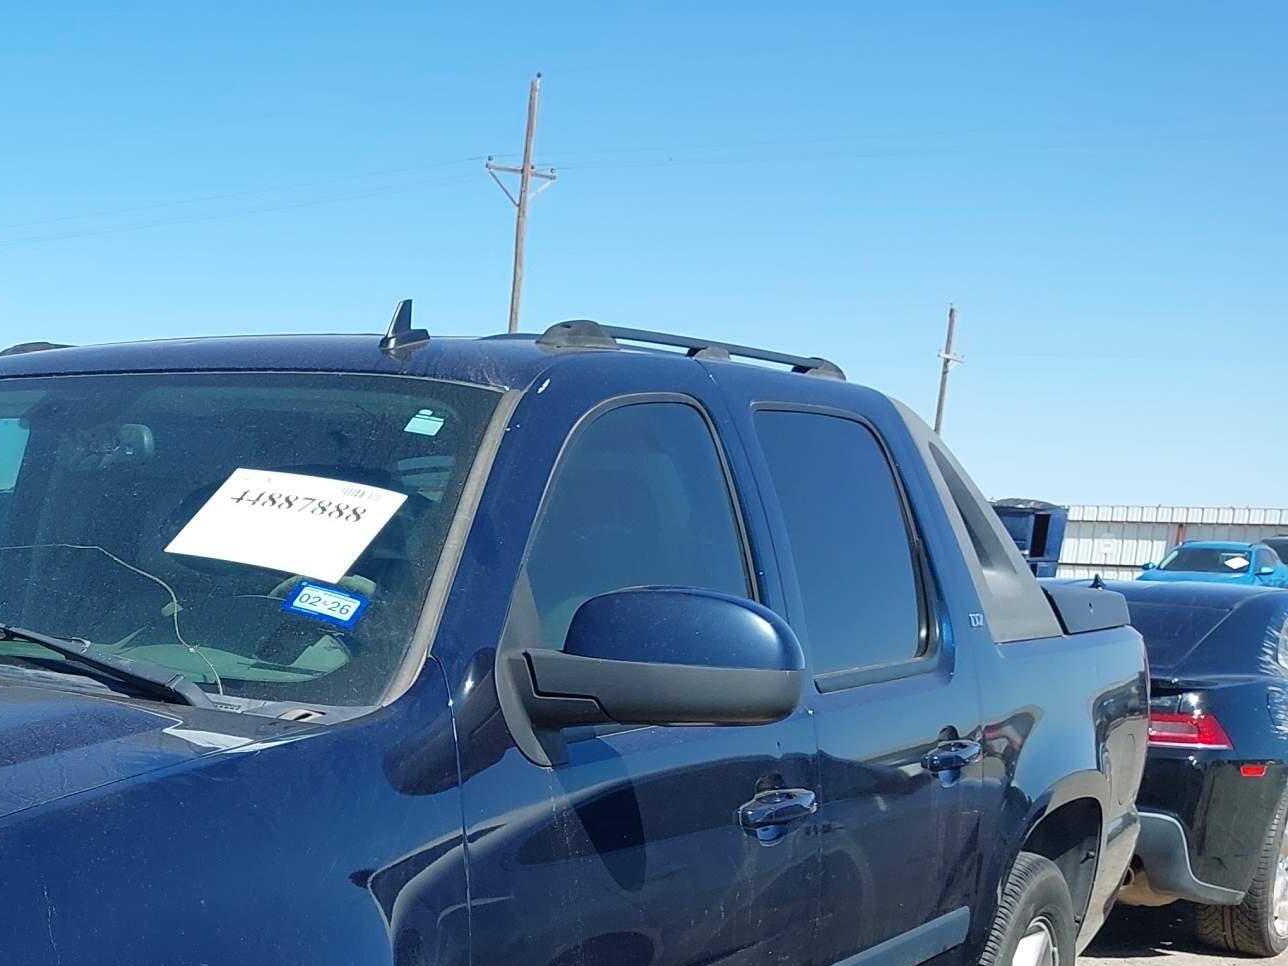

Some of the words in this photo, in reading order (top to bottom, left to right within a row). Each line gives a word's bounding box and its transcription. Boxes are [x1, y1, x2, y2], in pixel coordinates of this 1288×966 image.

[230, 489, 367, 523] 44887888
[298, 593, 322, 607] 02
[327, 601, 352, 615] 26
